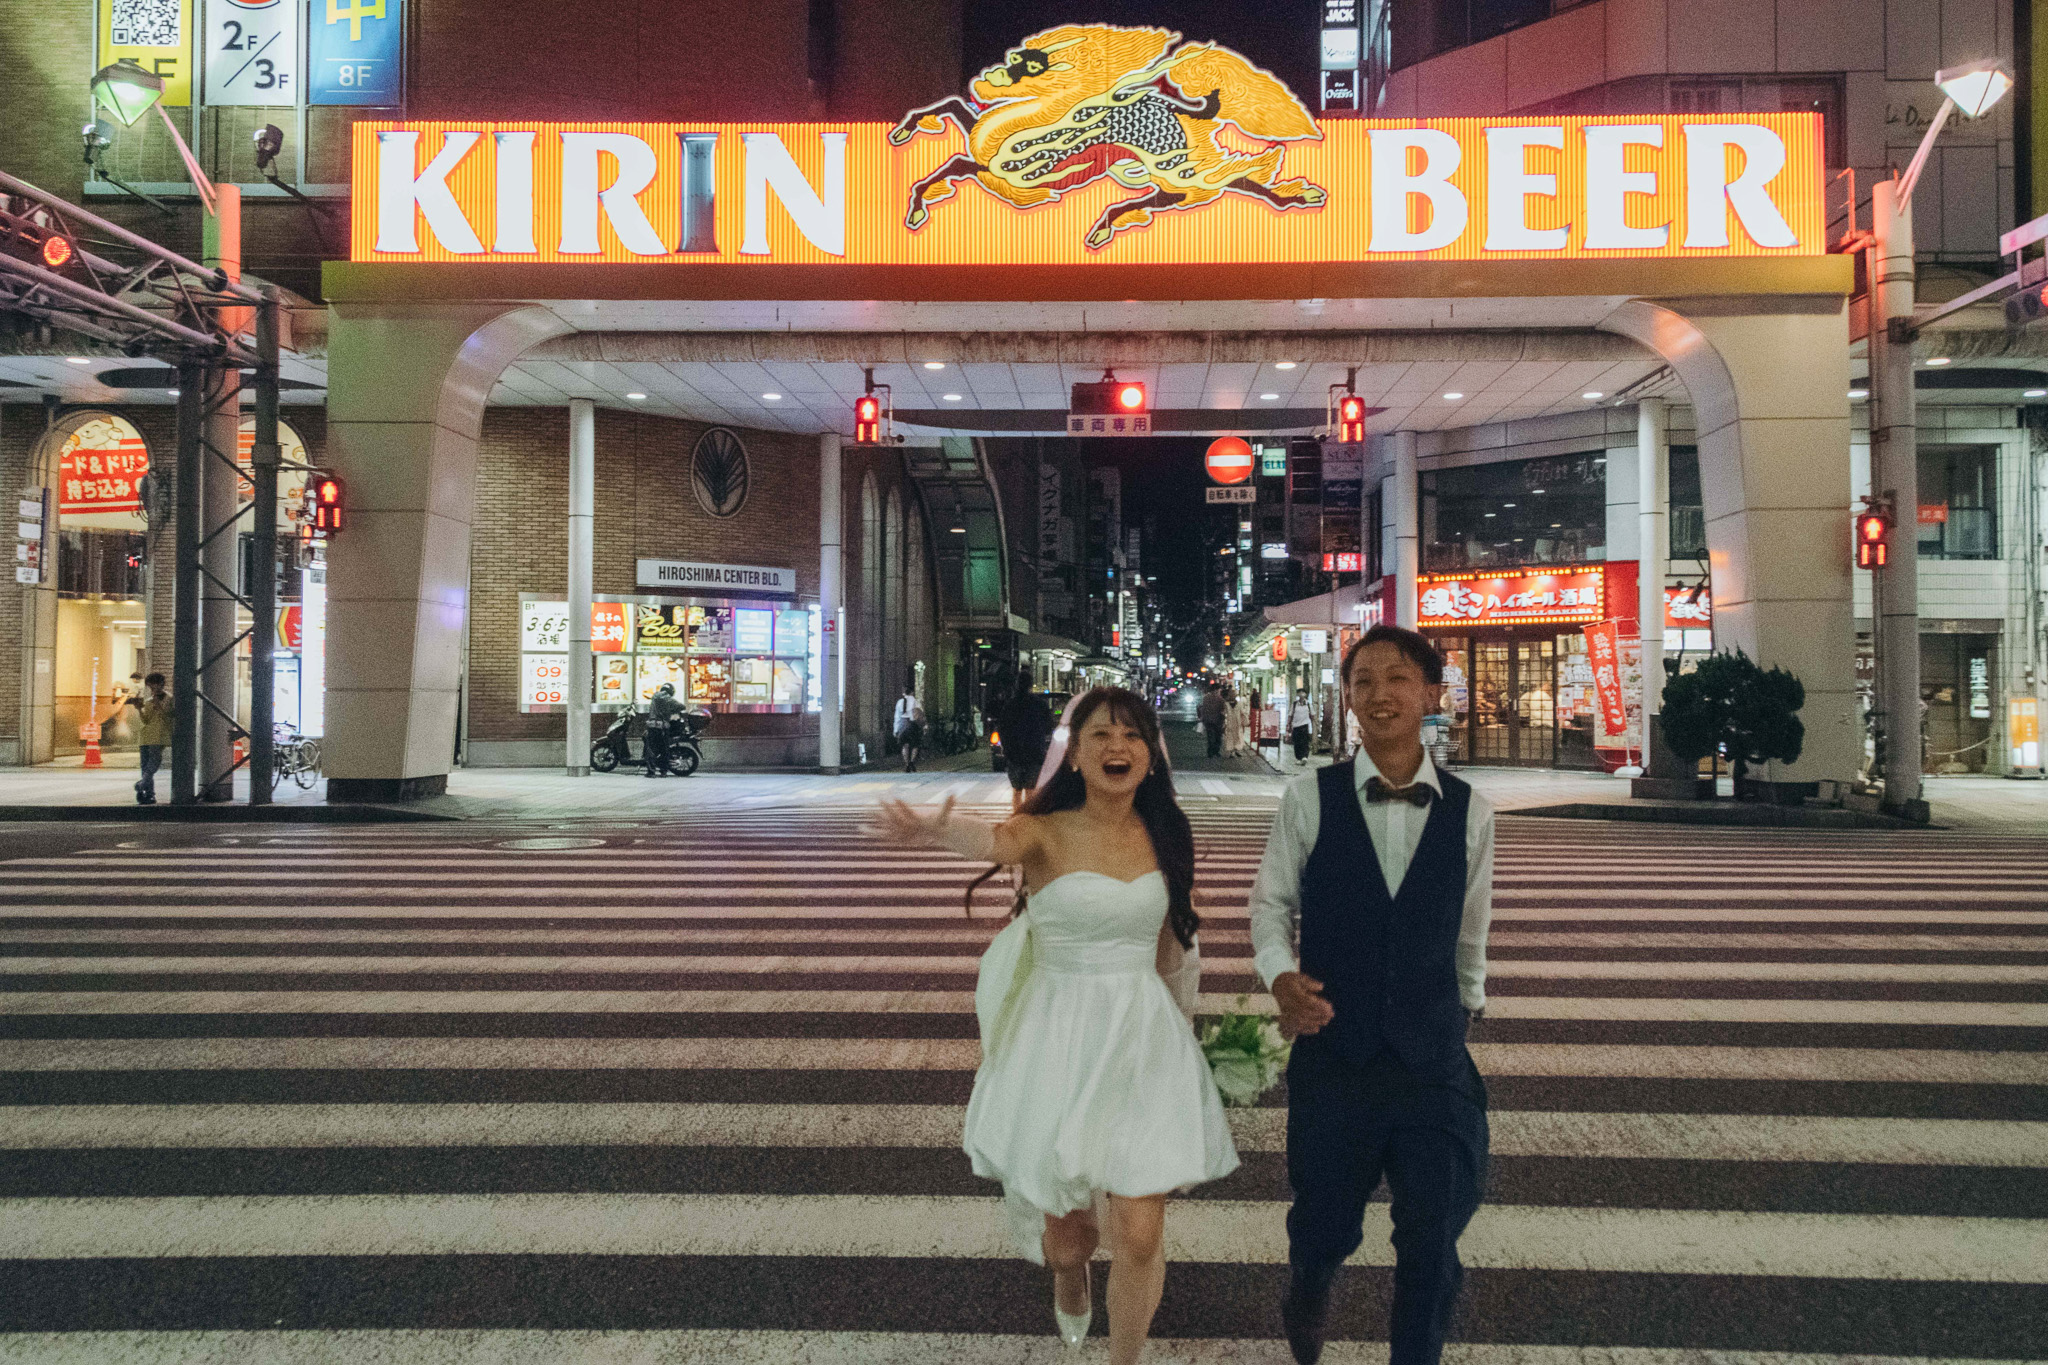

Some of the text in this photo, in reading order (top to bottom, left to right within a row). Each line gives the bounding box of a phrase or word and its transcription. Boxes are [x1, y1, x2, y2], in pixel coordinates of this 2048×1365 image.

[1325, 8, 1355, 22] JACK
[222, 20, 257, 50] 2F
[118, 58, 177, 78] F
[254, 59, 289, 89] 3F
[339, 65, 372, 87] 8F
[373, 124, 1801, 257] KIRIN BEER
[1071, 417, 1147, 432] 車両専用
[1209, 488, 1253, 501] 自転車を除く
[658, 566, 782, 586] HIROSHIMA CENTER BLD.
[716, 608, 730, 617] 7F
[591, 626, 624, 641] 王将
[639, 615, 682, 637] Bee
